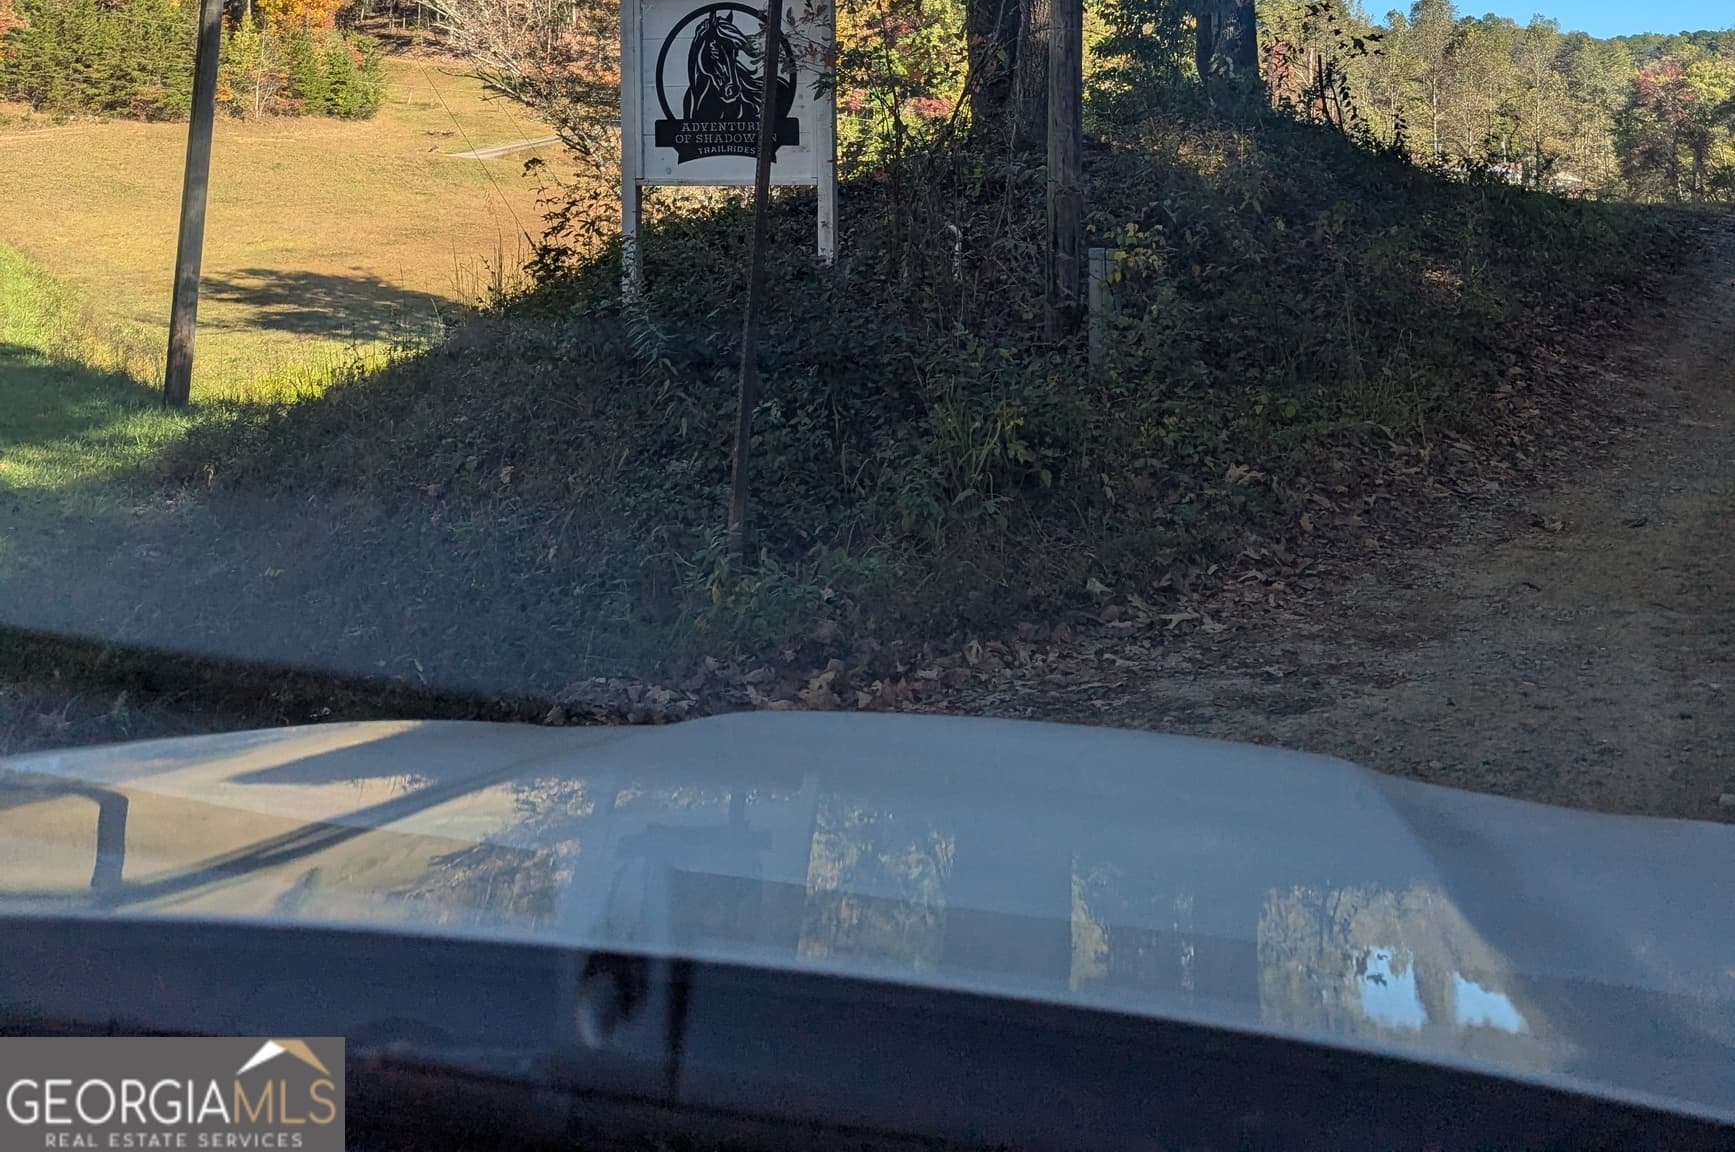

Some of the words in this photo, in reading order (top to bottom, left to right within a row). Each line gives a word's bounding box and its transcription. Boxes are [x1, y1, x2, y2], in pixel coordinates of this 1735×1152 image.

[681, 121, 761, 132] ADVENTUR
[675, 134, 692, 143] OF
[695, 133, 757, 143] SHADOW
